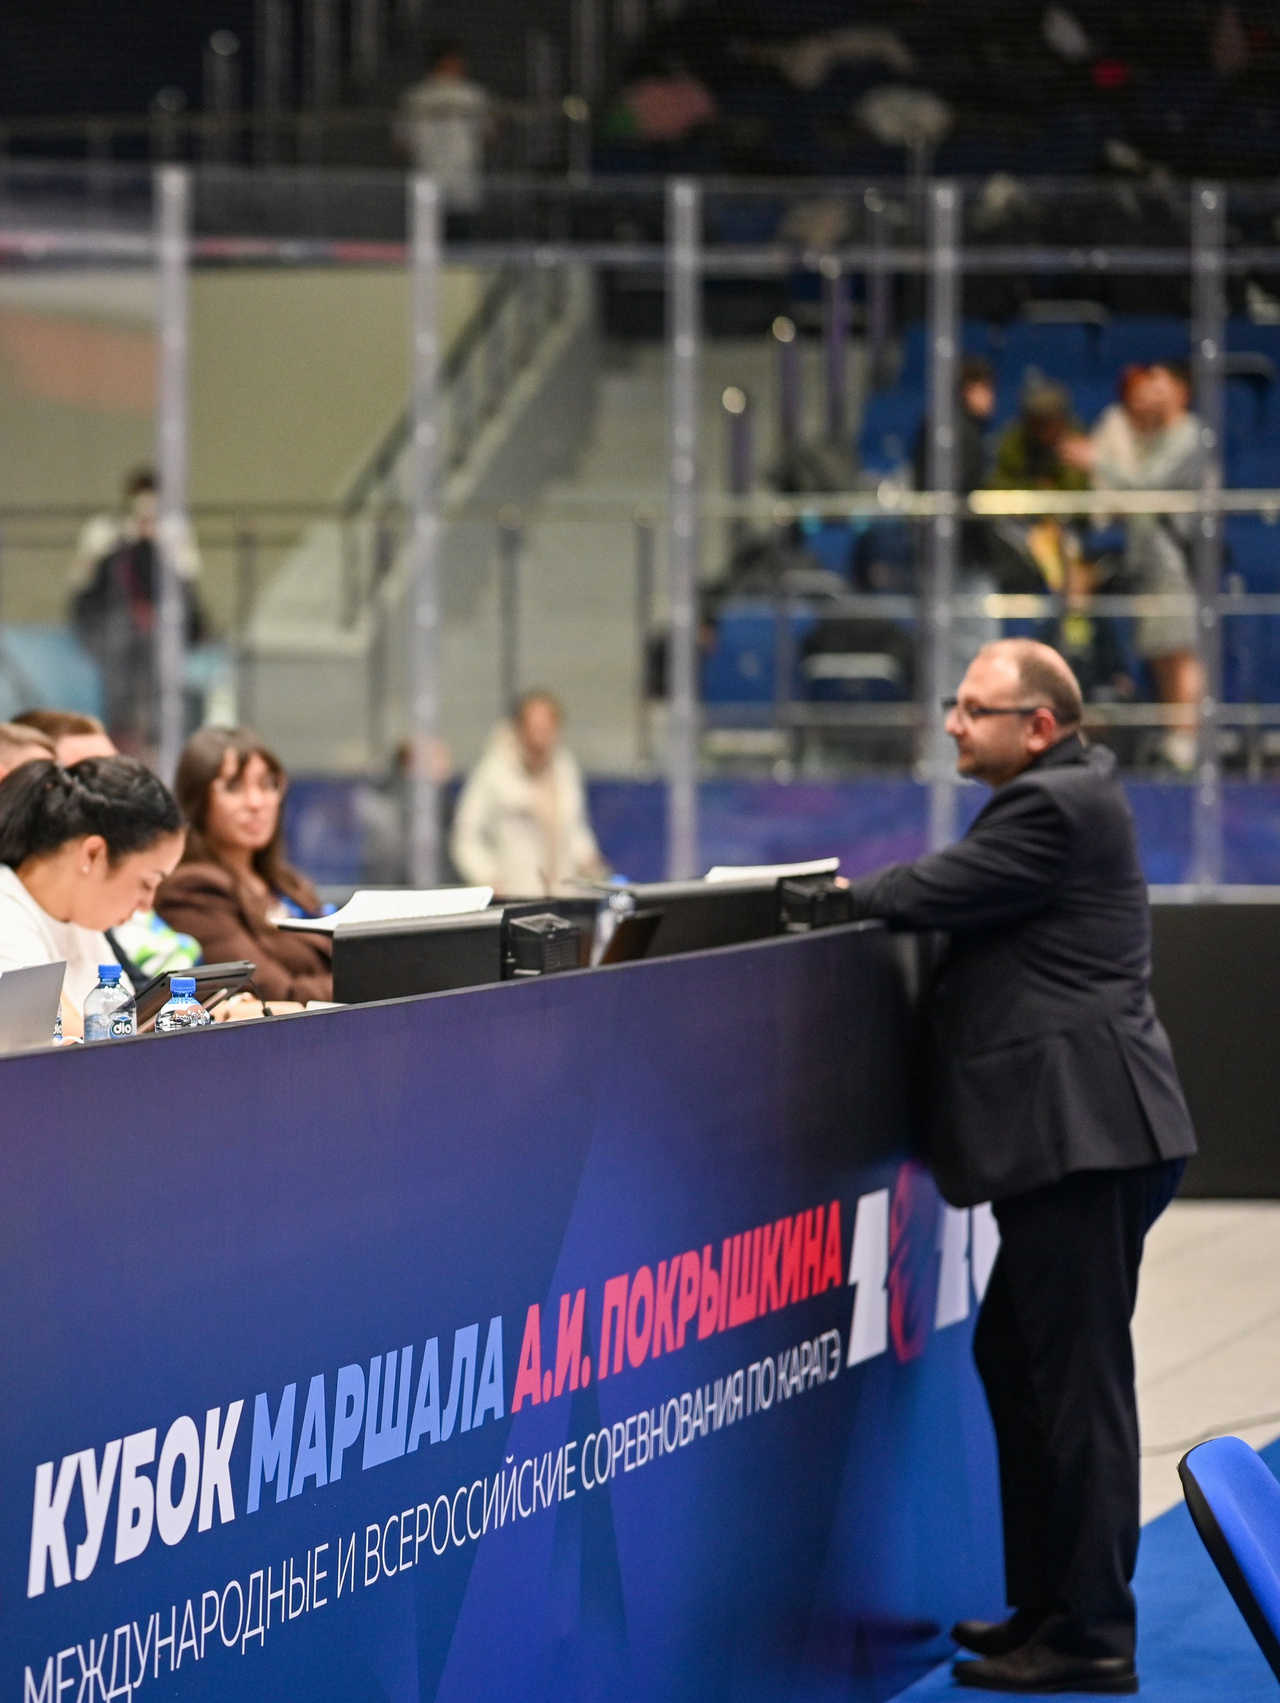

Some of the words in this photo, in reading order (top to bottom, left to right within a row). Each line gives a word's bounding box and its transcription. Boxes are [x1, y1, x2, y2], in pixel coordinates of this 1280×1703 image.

[24, 1542, 329, 1703] МЕЖДУНАРОДНЫЕ
[336, 1531, 356, 1599] И
[364, 1442, 577, 1588] ВСЕРОССИЙСКИЕ
[581, 1369, 744, 1490] СОРЕВНОВАНИЯ
[746, 1356, 776, 1417] ПО
[777, 1328, 842, 1403] КАРАТЭ
[27, 1399, 244, 1599] КУБОК
[246, 1315, 504, 1515] МАРШАЛА
[511, 1288, 591, 1413] А.И.
[598, 1200, 842, 1381] ПОКРЫШКИНА
